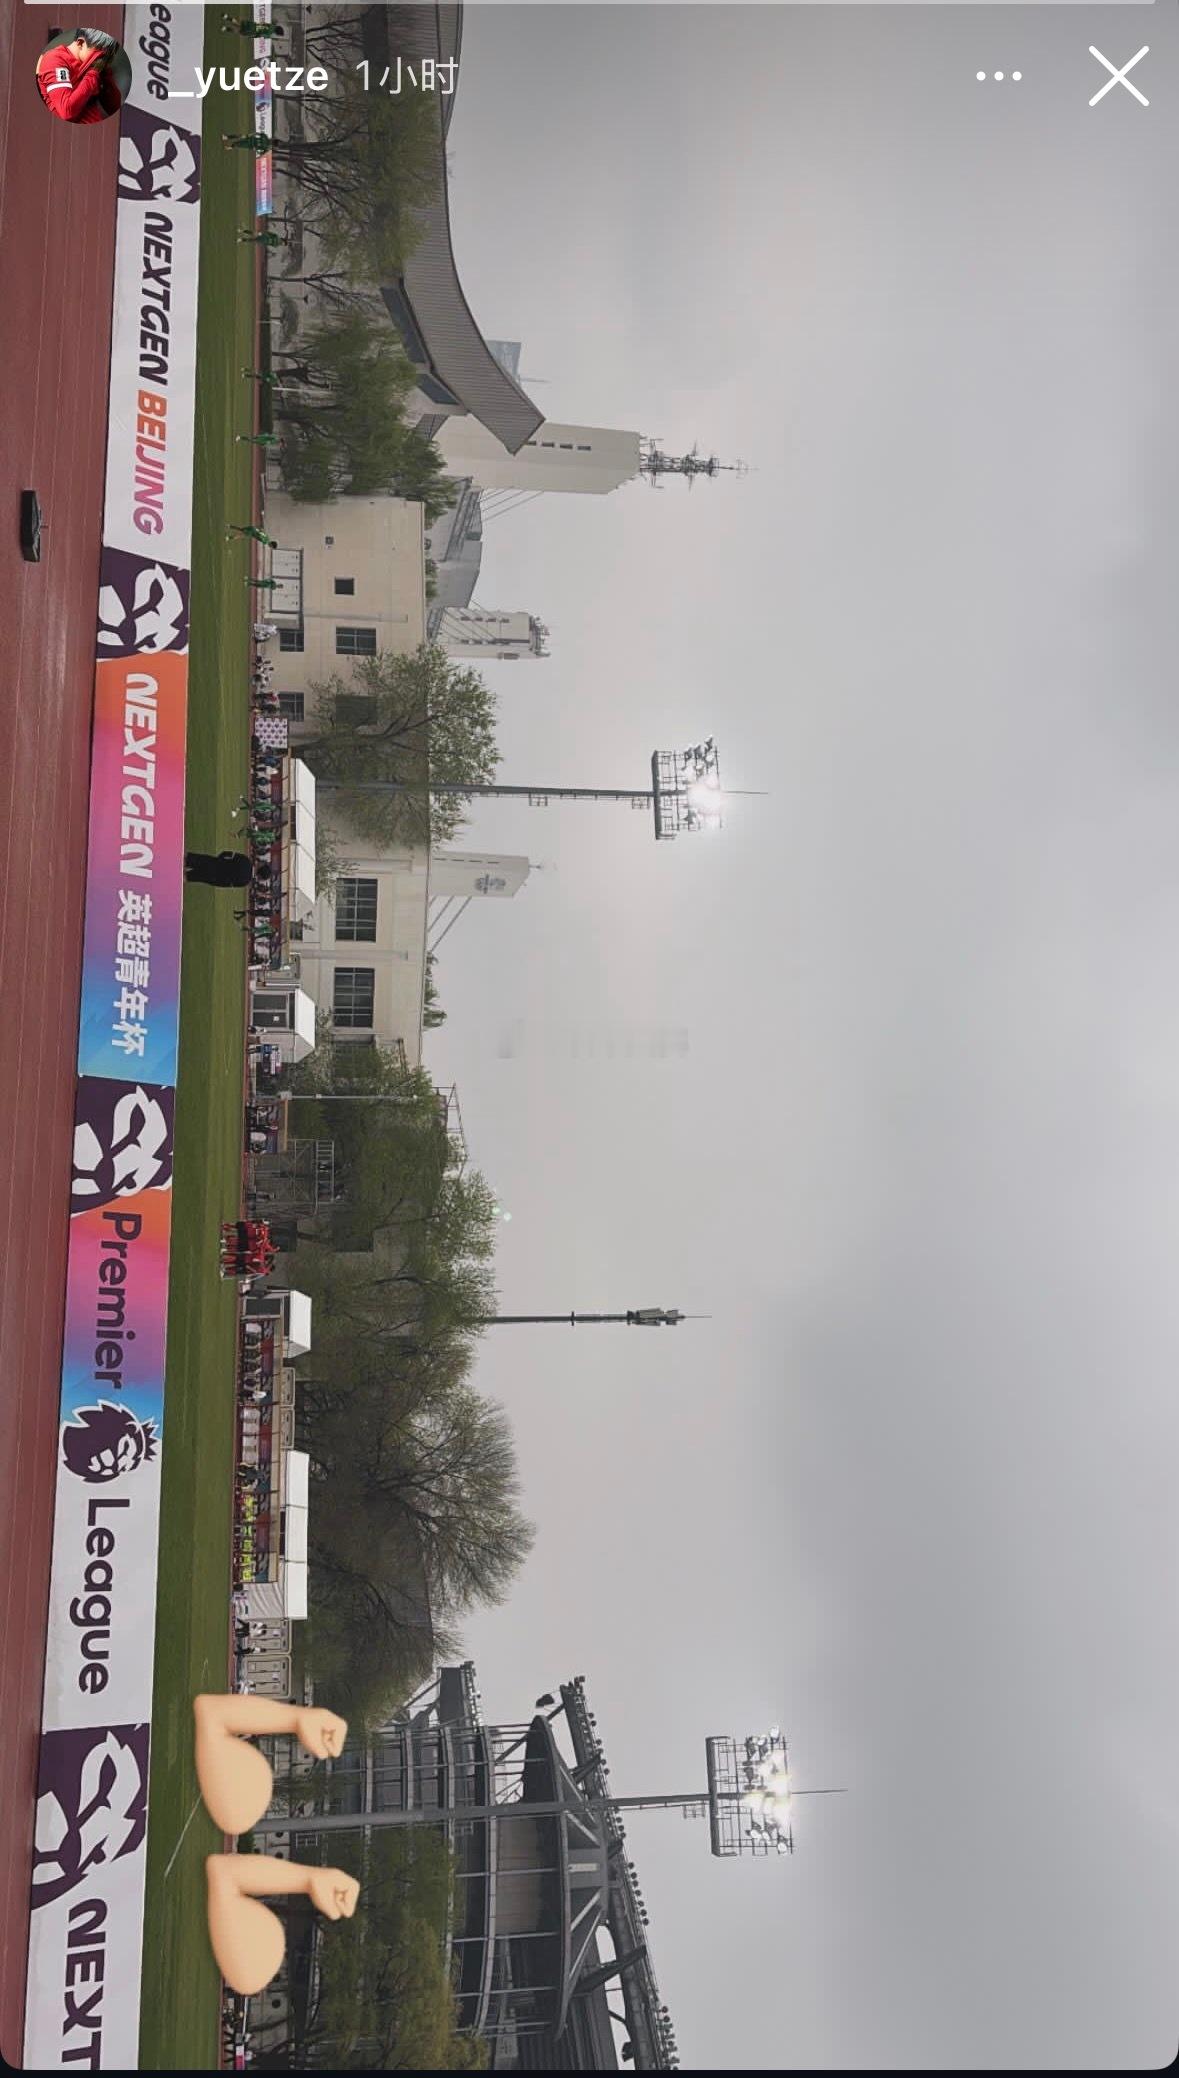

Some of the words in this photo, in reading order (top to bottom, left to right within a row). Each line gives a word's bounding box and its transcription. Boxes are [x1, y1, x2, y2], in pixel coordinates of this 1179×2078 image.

[138, 211, 173, 386] NEXTGEN
[133, 389, 168, 535] BEIJING
[120, 673, 159, 879] NEXTGEN
[112, 889, 153, 1057] 英超青年杯
[94, 1211, 142, 1390] Premier
[69, 1498, 130, 1695] League
